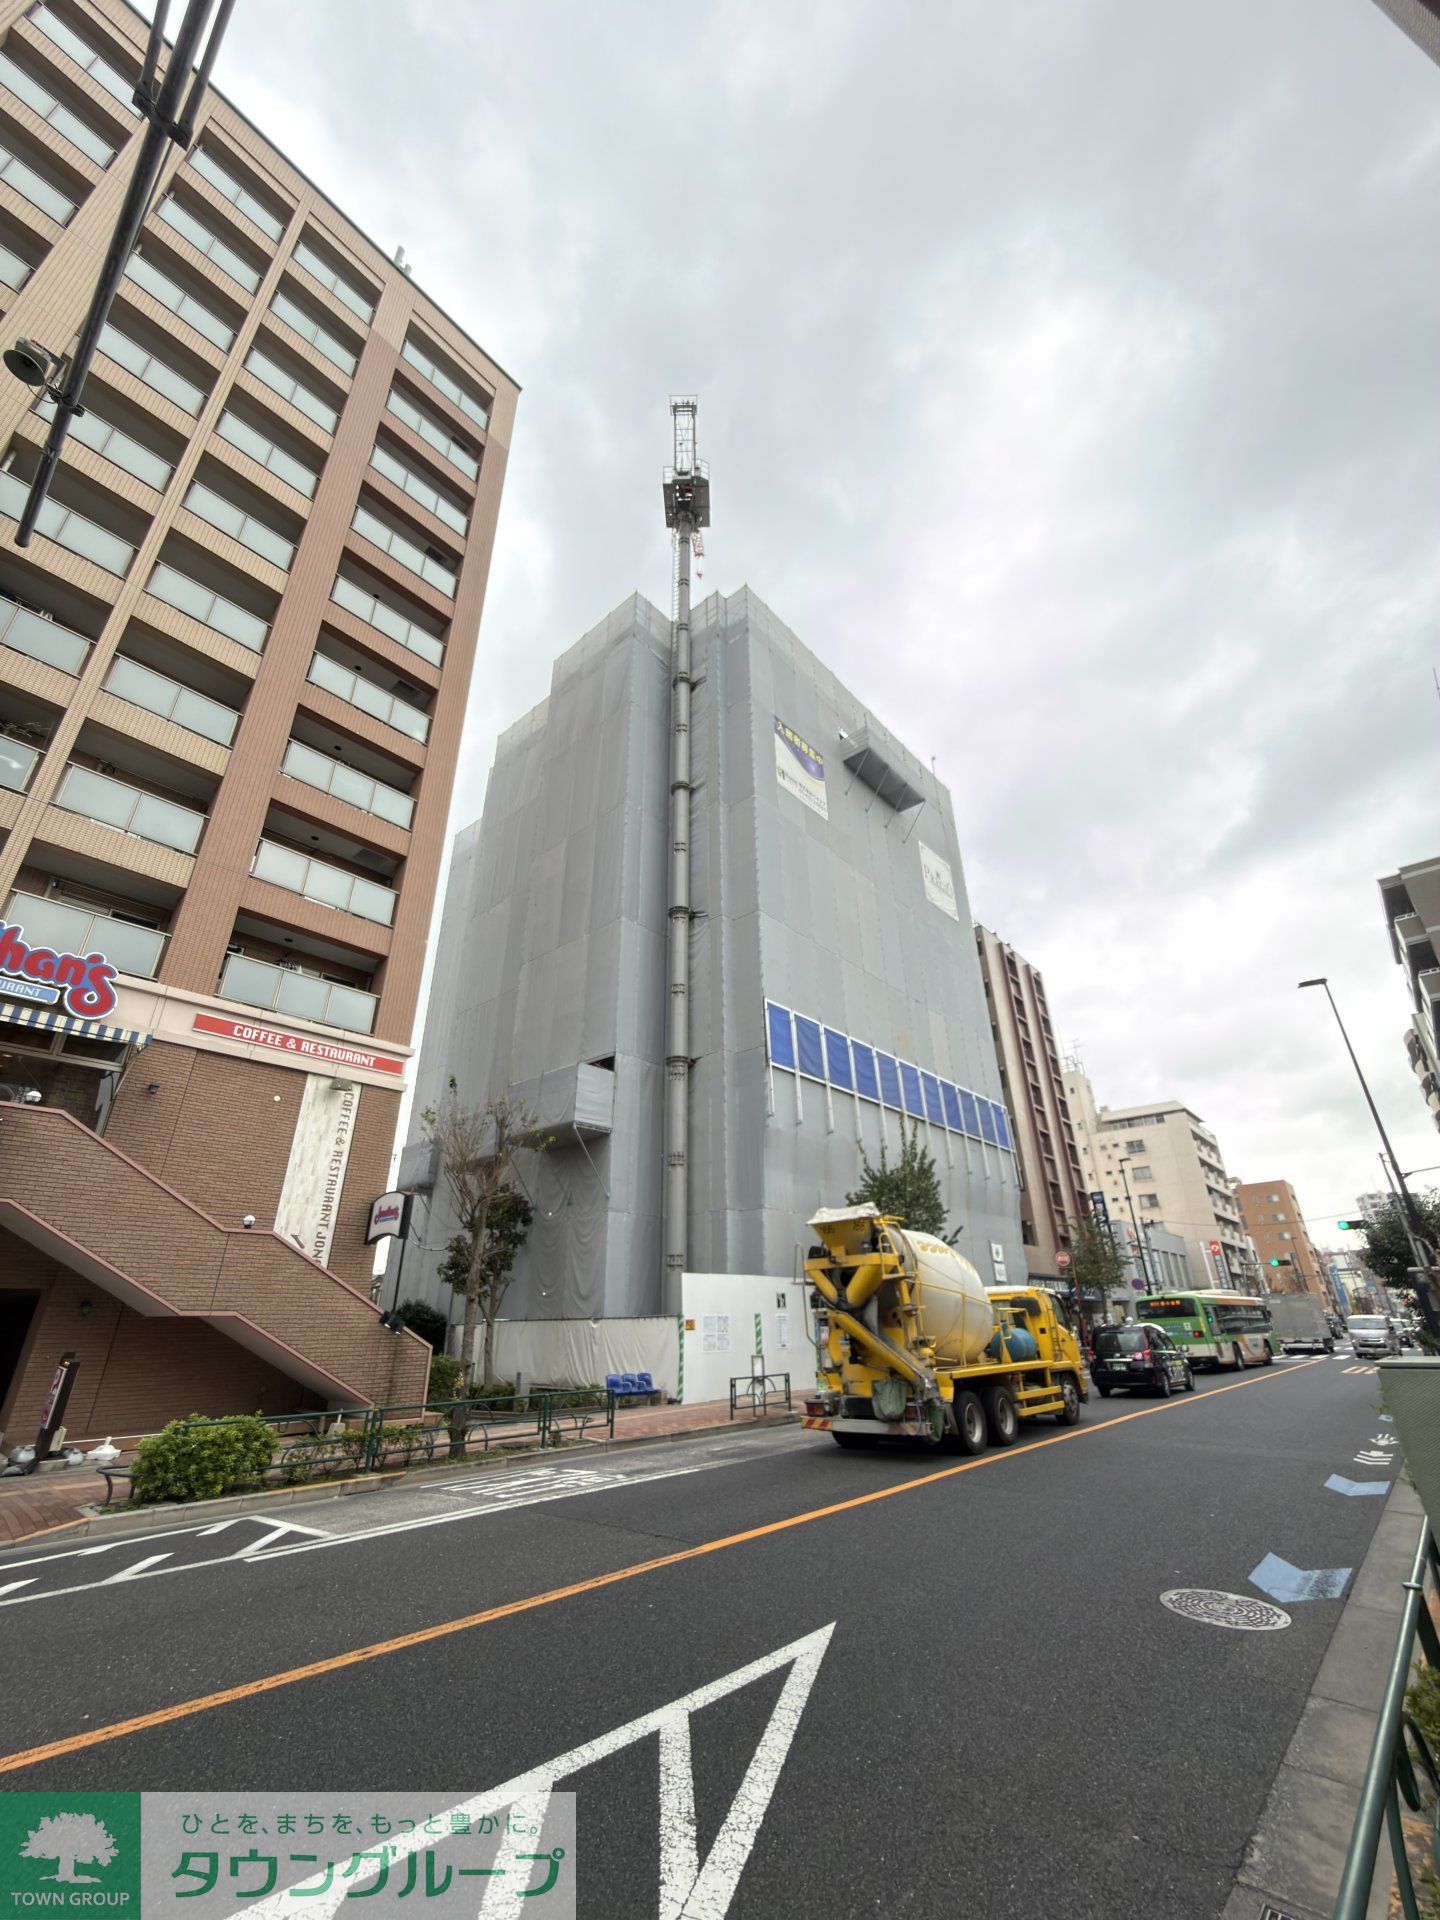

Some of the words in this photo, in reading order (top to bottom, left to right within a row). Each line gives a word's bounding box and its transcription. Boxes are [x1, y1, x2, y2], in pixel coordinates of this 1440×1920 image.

[0, 925, 117, 1018] han's
[233, 1025, 284, 1047] COFFEE
[286, 1038, 297, 1050] &
[301, 1041, 376, 1067] RESTAURANT
[337, 1092, 354, 1135] COFFEE
[335, 1137, 346, 1146] &
[318, 1150, 343, 1229] RESTAURANT
